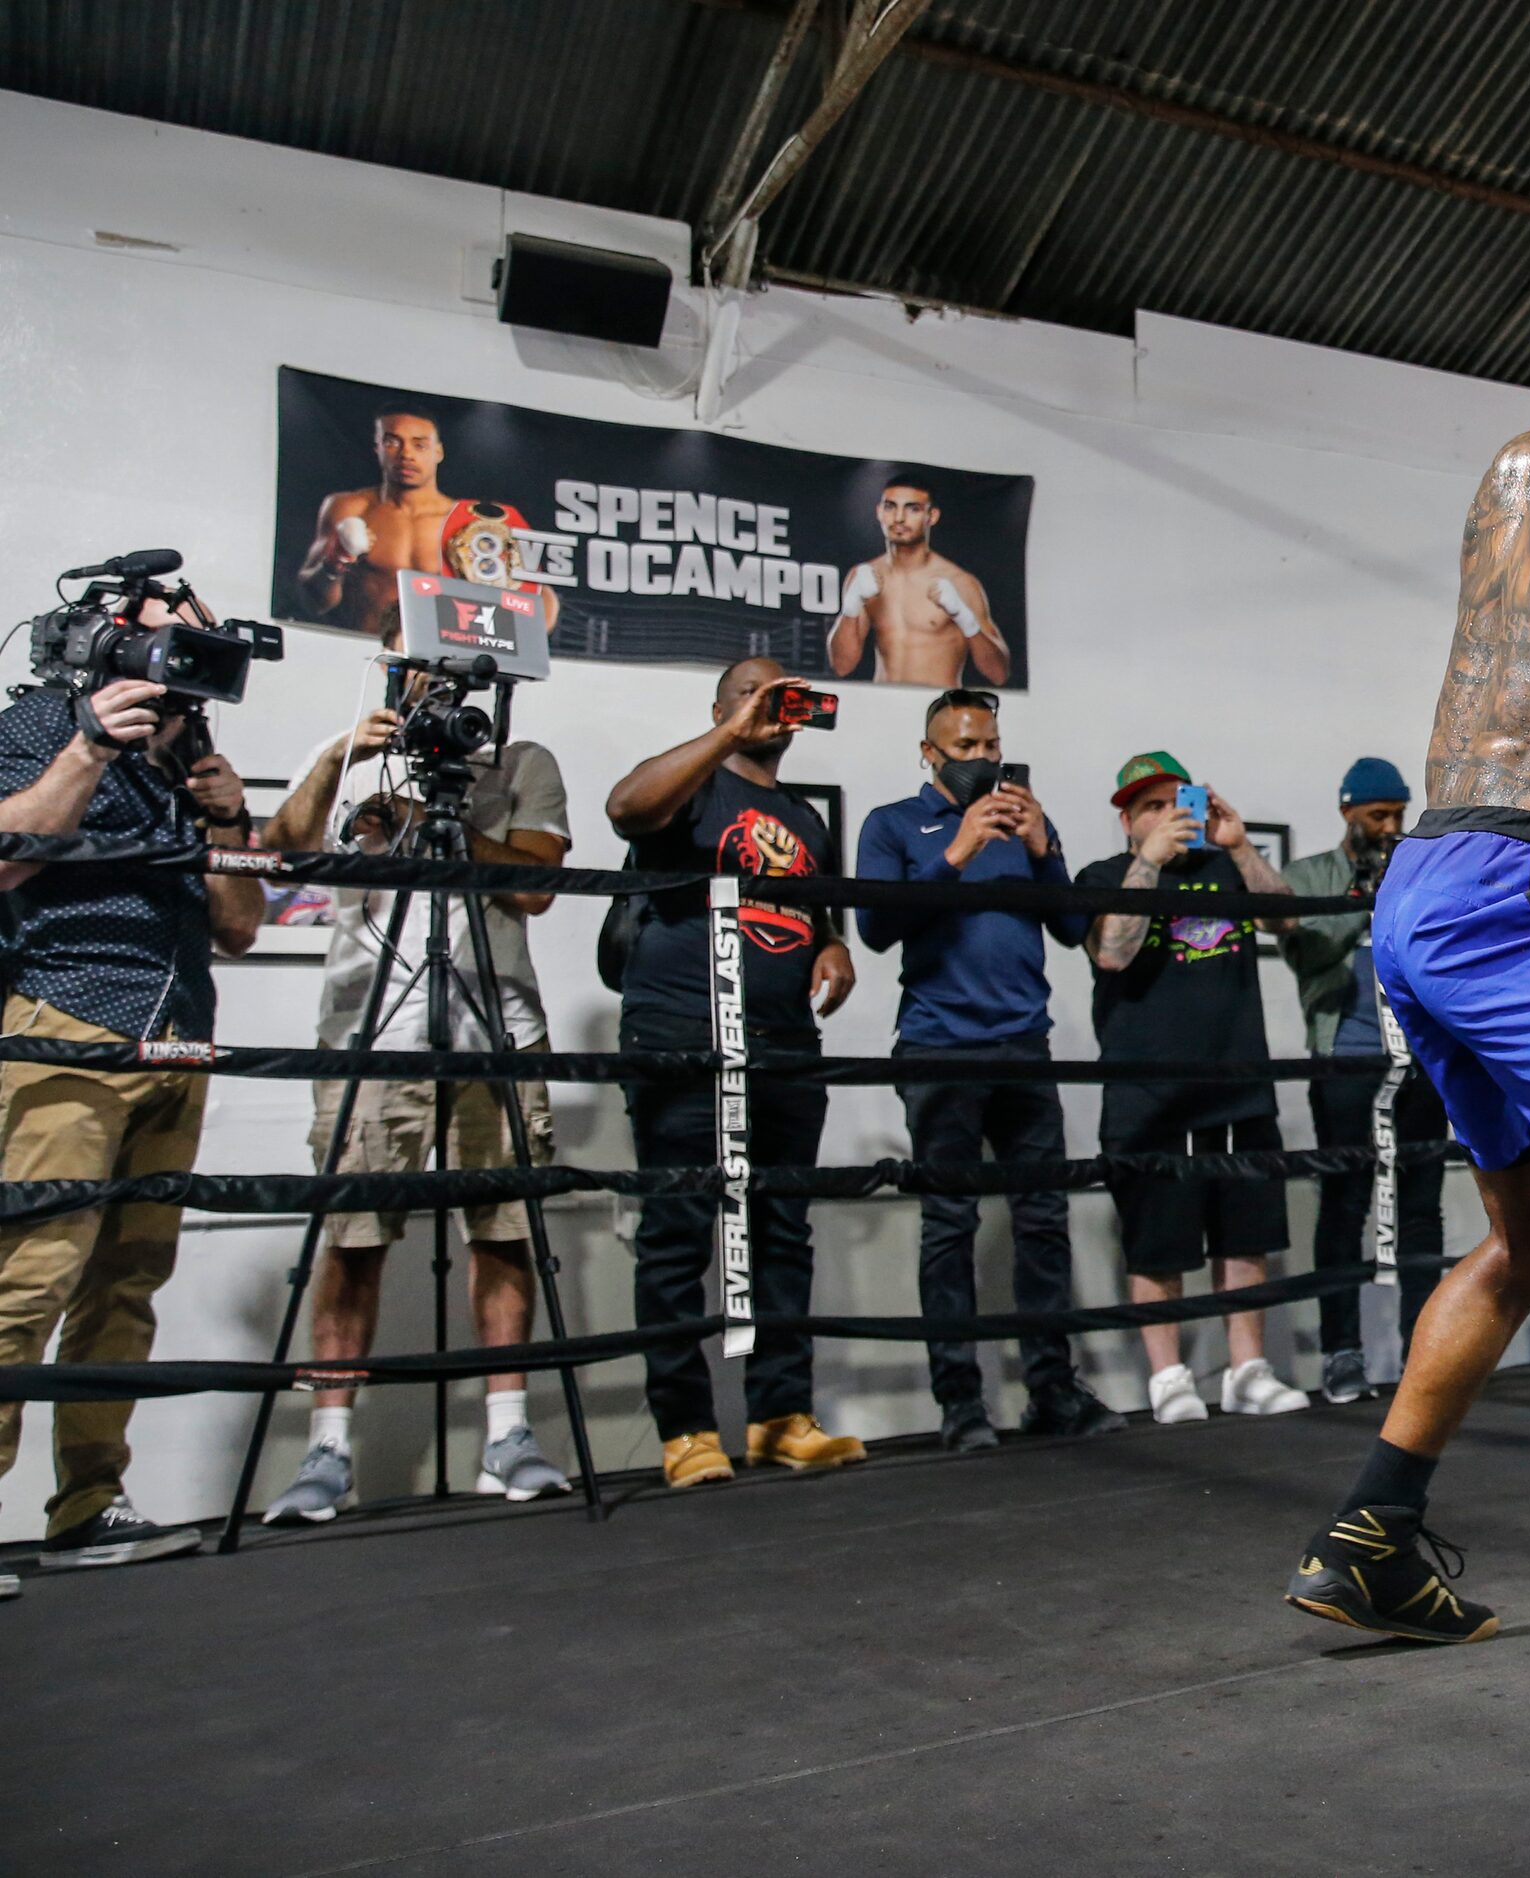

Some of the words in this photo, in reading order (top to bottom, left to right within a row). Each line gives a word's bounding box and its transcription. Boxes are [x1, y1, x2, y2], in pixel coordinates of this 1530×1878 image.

[555, 479, 791, 558] SPENCE
[505, 597, 530, 612] LIVE
[518, 538, 575, 578] VS
[586, 537, 841, 615] OCAMPO
[440, 629, 515, 651] FIGHTHYPE
[715, 909, 747, 1095] EVERLAST
[722, 1132, 752, 1319] EVERLAST
[1374, 1108, 1398, 1266] EVERLAST
